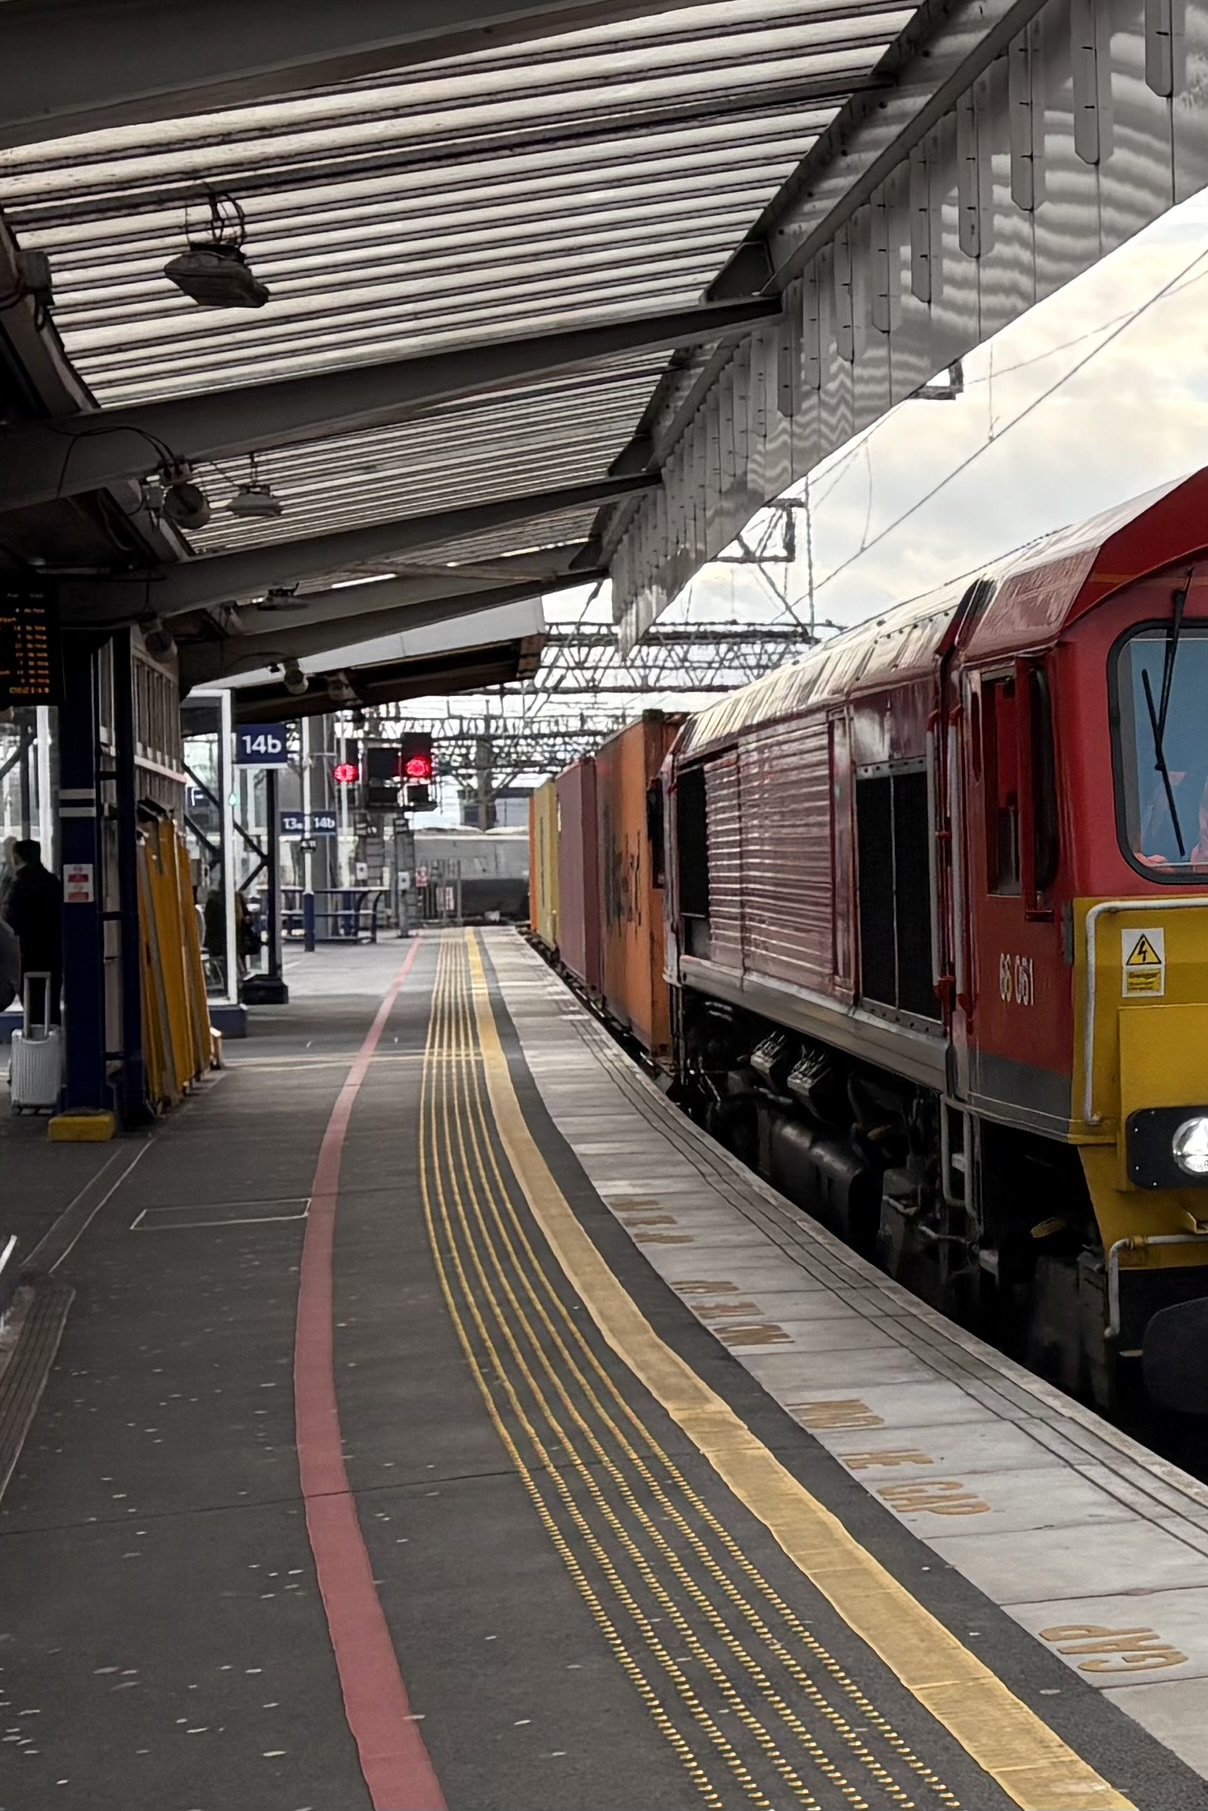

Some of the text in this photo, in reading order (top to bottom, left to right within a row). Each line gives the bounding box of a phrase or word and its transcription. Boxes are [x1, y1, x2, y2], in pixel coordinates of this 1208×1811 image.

[242, 735, 282, 754] 14b
[313, 817, 336, 829] 14b
[1000, 952, 1034, 1006] 66 061
[1038, 1624, 1190, 1673] GAP
